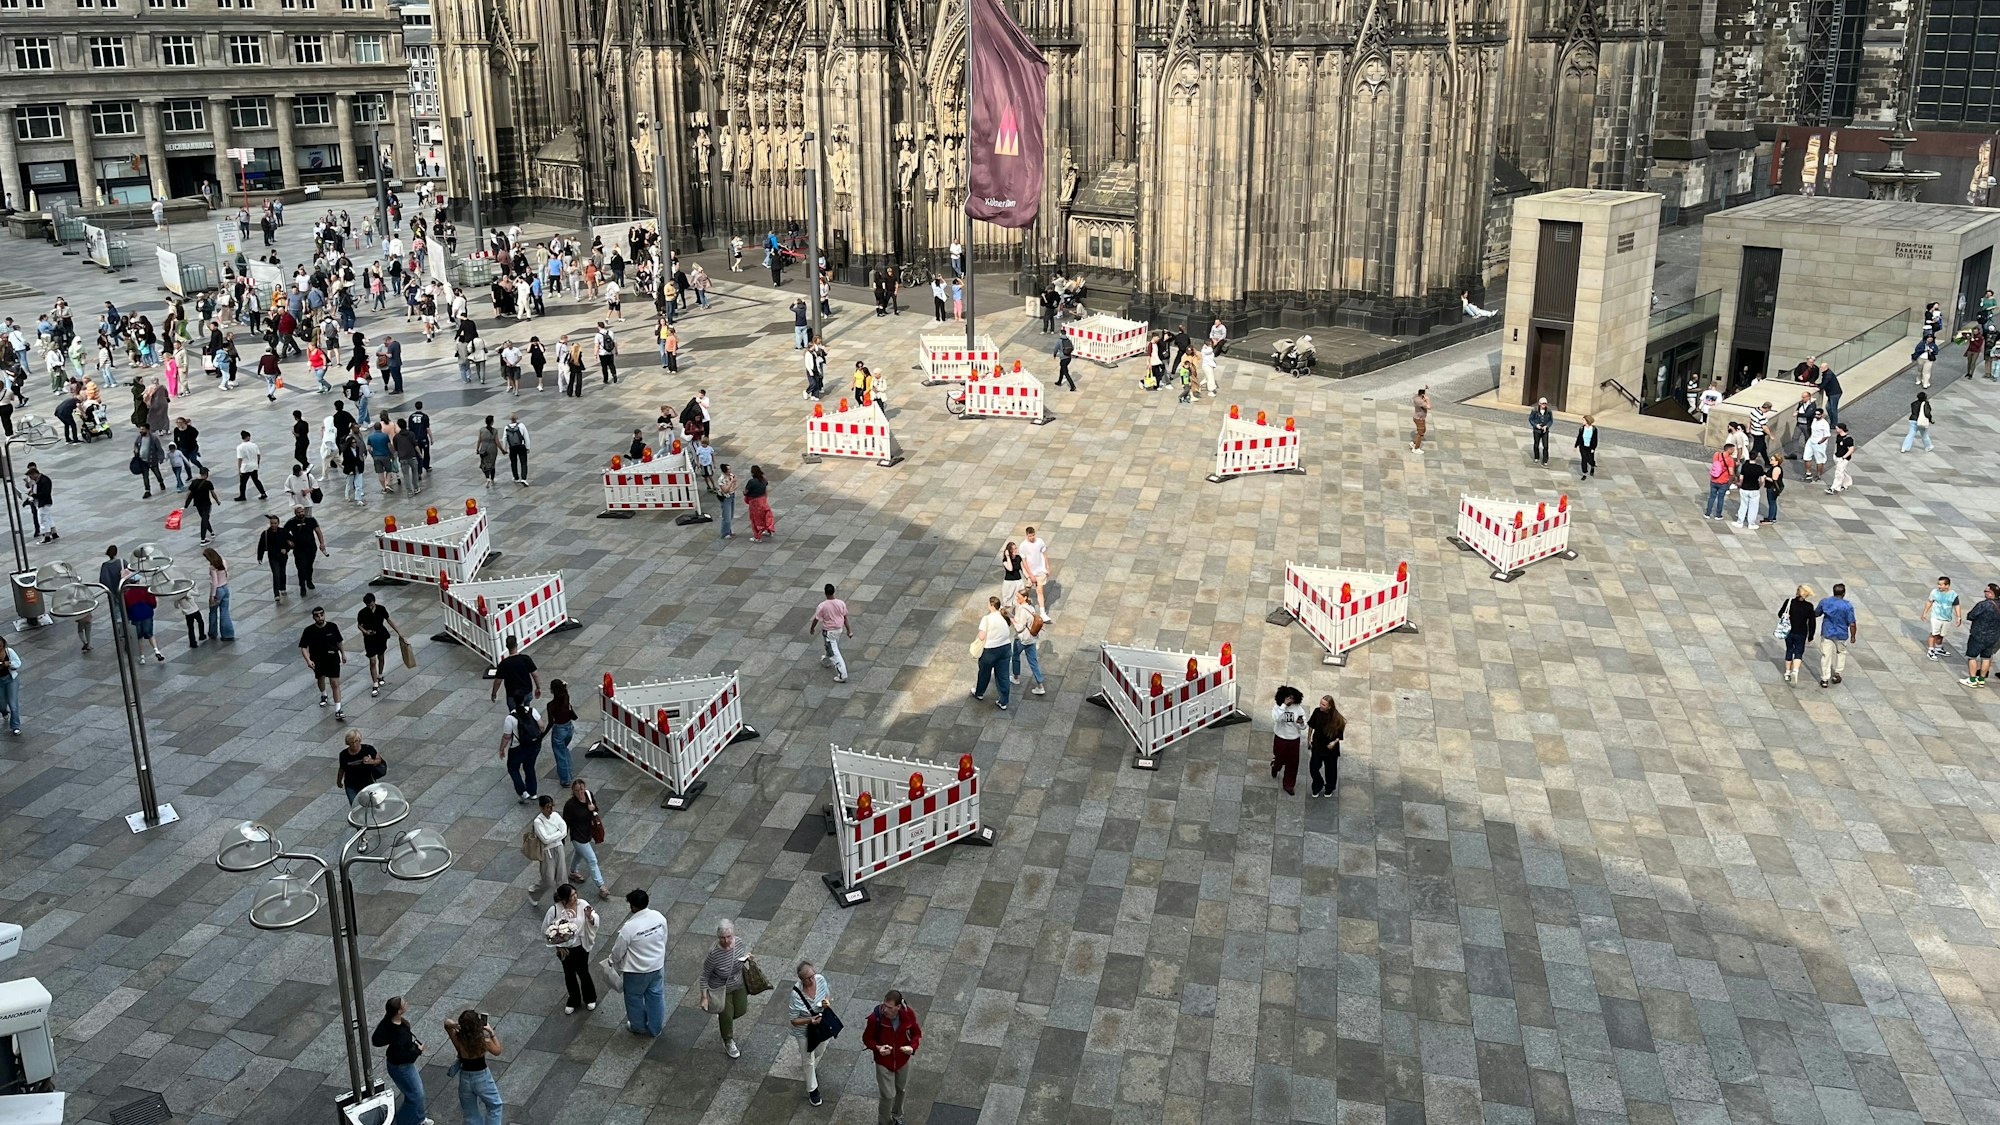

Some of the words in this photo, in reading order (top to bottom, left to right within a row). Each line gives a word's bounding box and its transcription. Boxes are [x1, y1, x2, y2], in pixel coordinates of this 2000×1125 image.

[1896, 241, 1933, 250] DOM-TURM
[1895, 247, 1932, 255] PARKHAUS
[1894, 252, 1932, 260] TOILETTEN
